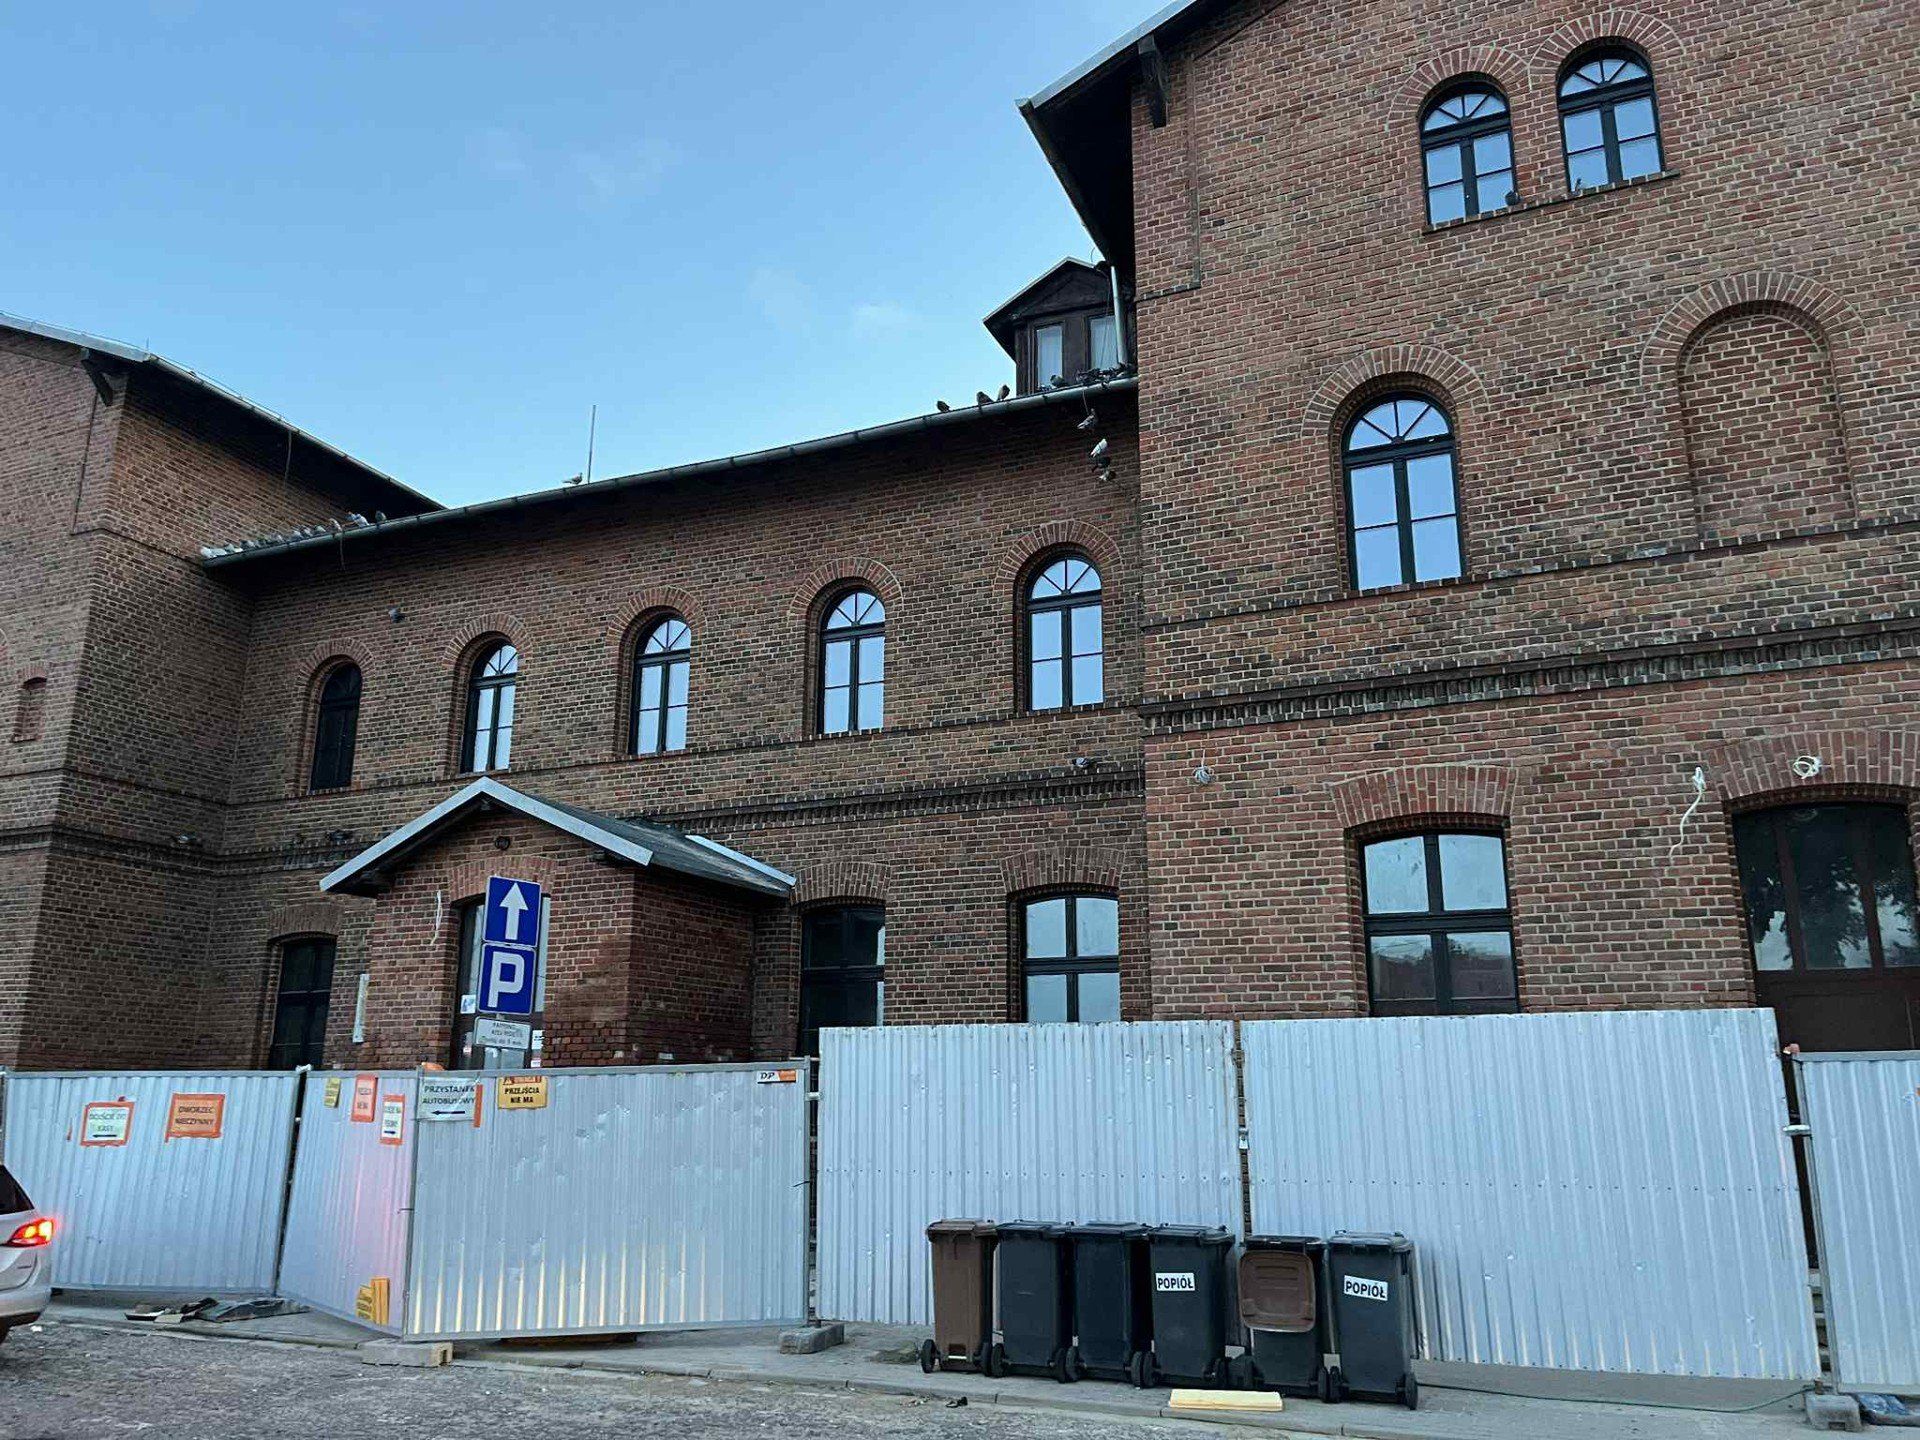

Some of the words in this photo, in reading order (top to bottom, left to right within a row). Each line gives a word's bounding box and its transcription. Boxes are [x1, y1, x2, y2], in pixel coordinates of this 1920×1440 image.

[487, 951, 525, 1008] P
[504, 1086, 540, 1095] PRZEJŚCIA
[1157, 1275, 1194, 1289] POPIÓŁ
[1345, 1280, 1386, 1299] POPIÓŁ
